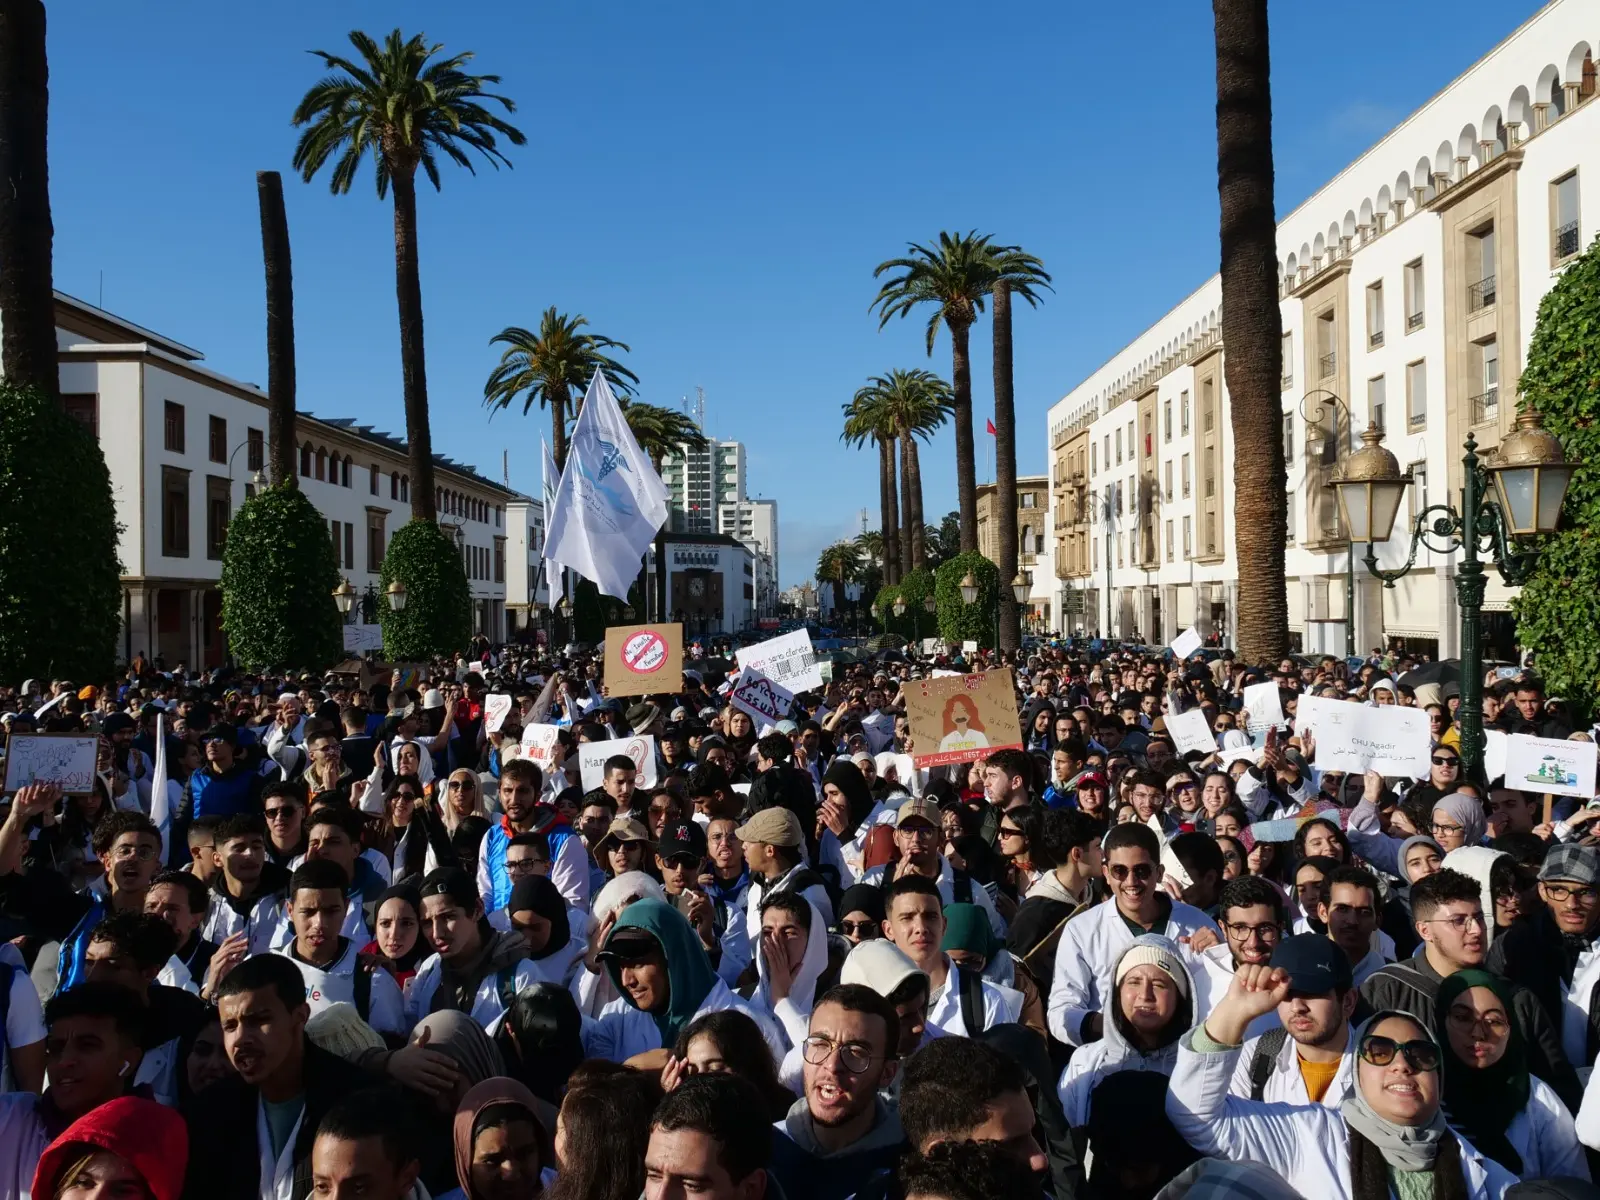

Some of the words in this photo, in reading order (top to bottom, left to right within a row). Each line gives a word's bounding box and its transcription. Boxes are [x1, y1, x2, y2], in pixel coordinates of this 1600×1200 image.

[746, 675, 791, 707] BOYCOTT
[1351, 737, 1368, 747] CHU
[1370, 741, 1396, 751] Agadir
